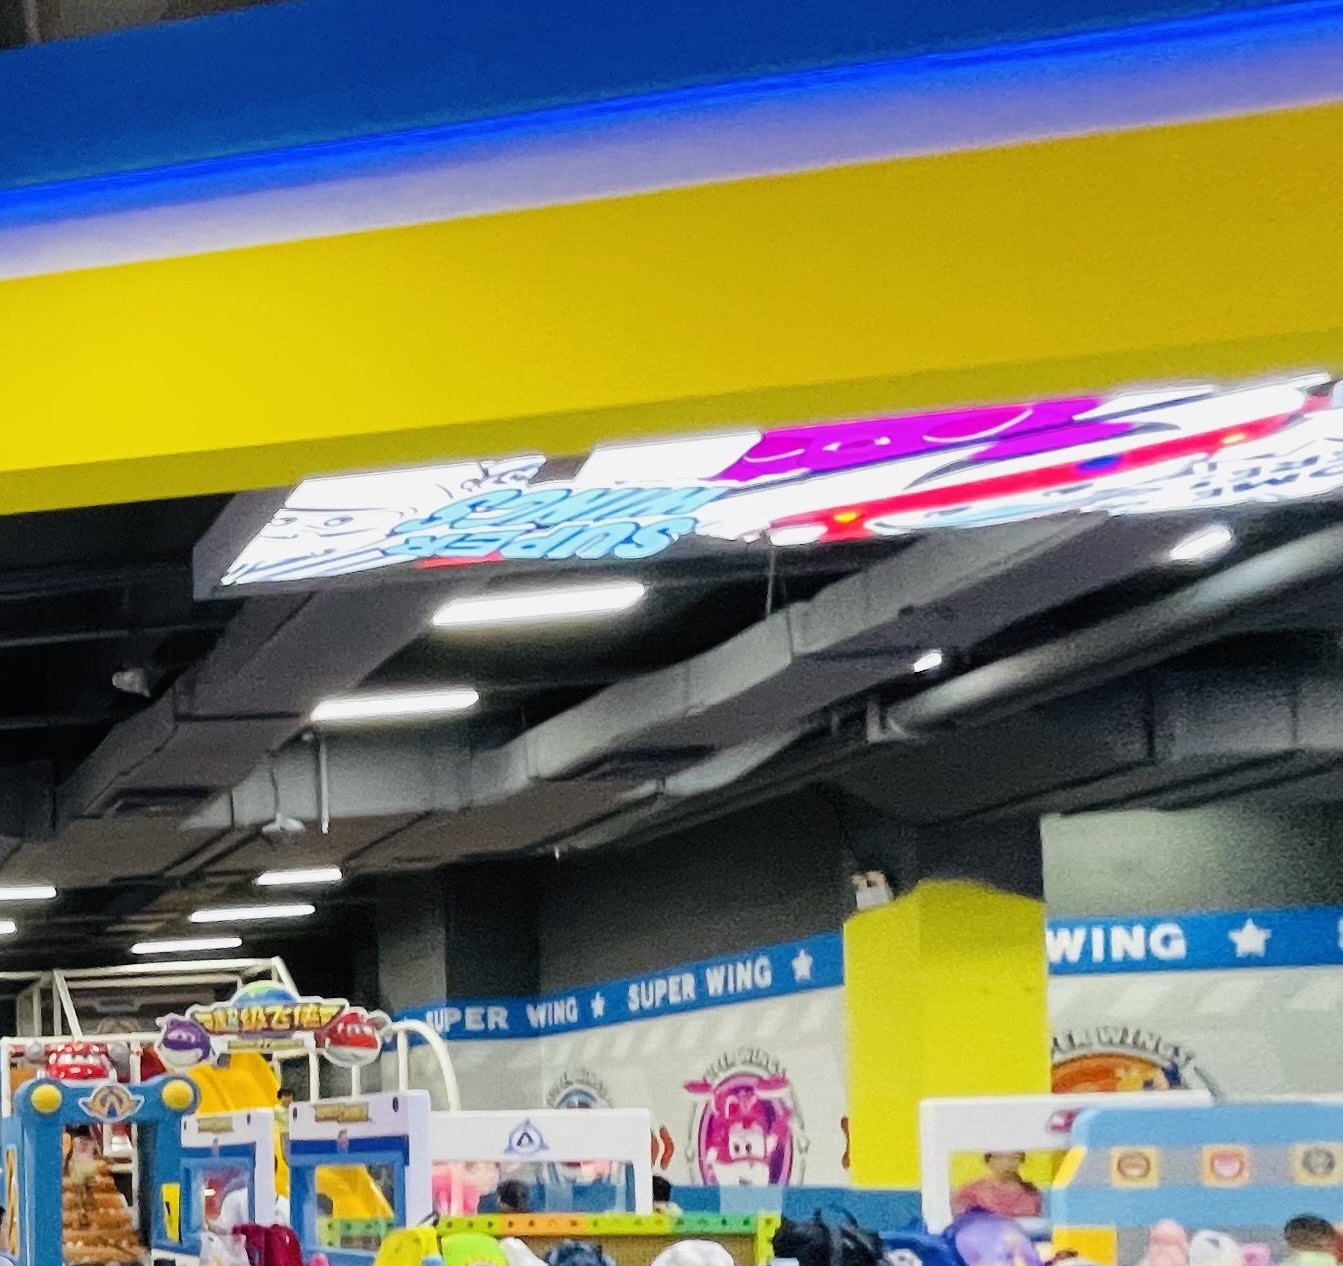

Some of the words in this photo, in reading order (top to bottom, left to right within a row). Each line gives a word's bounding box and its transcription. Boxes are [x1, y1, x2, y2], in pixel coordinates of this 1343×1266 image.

[418, 484, 729, 533] WINGS
[387, 516, 699, 561] SUPER
[1045, 922, 1188, 963] WING
[627, 971, 697, 1012] SUPER
[705, 956, 773, 997] WING
[525, 996, 579, 1028] WING
